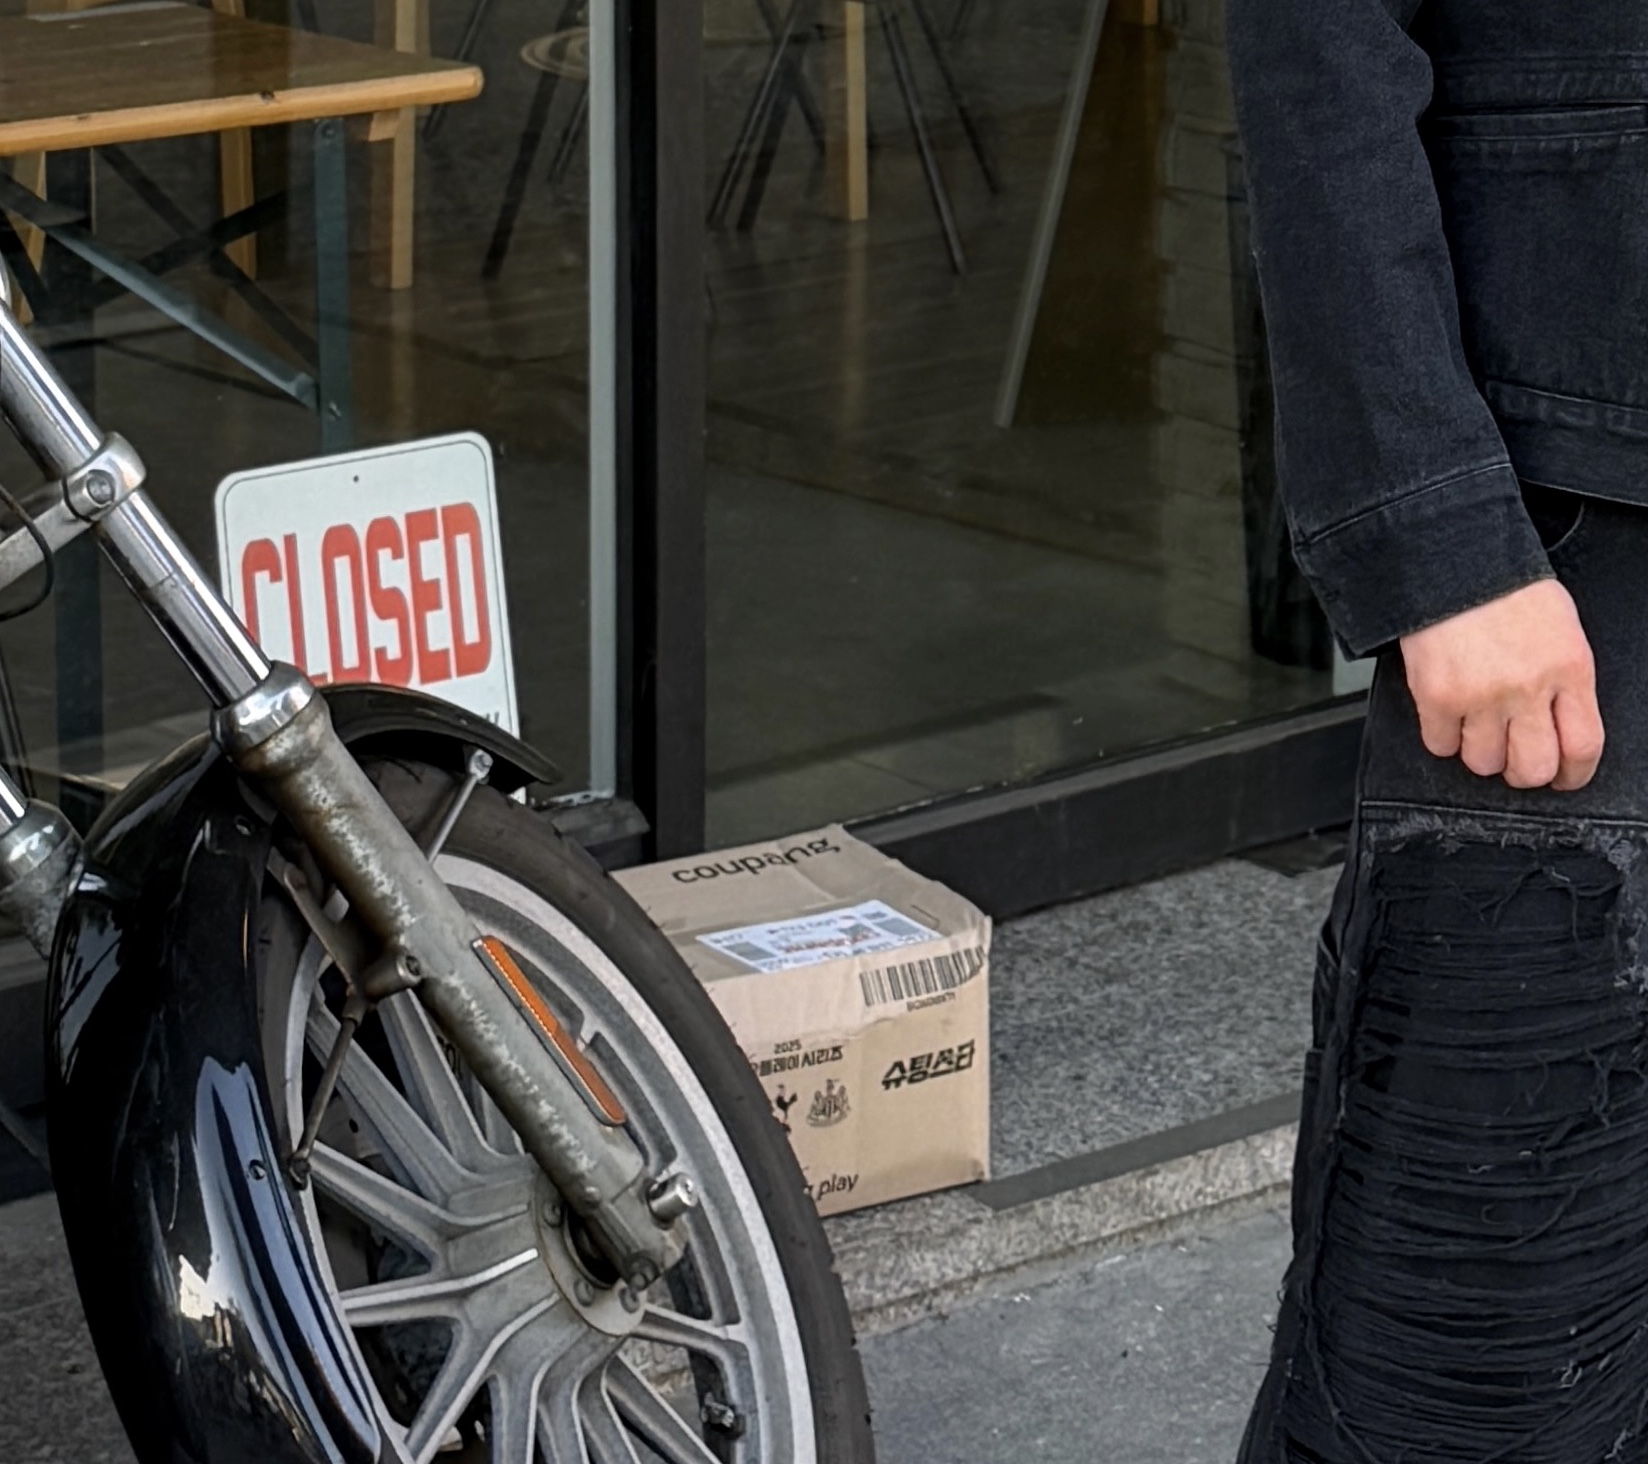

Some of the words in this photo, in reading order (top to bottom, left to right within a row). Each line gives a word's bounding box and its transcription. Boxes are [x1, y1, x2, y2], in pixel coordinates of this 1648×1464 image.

[241, 501, 492, 688] CLOSED
[671, 837, 841, 884] coupang
[774, 1039, 802, 1054] 2025
[816, 1173, 859, 1201] play
